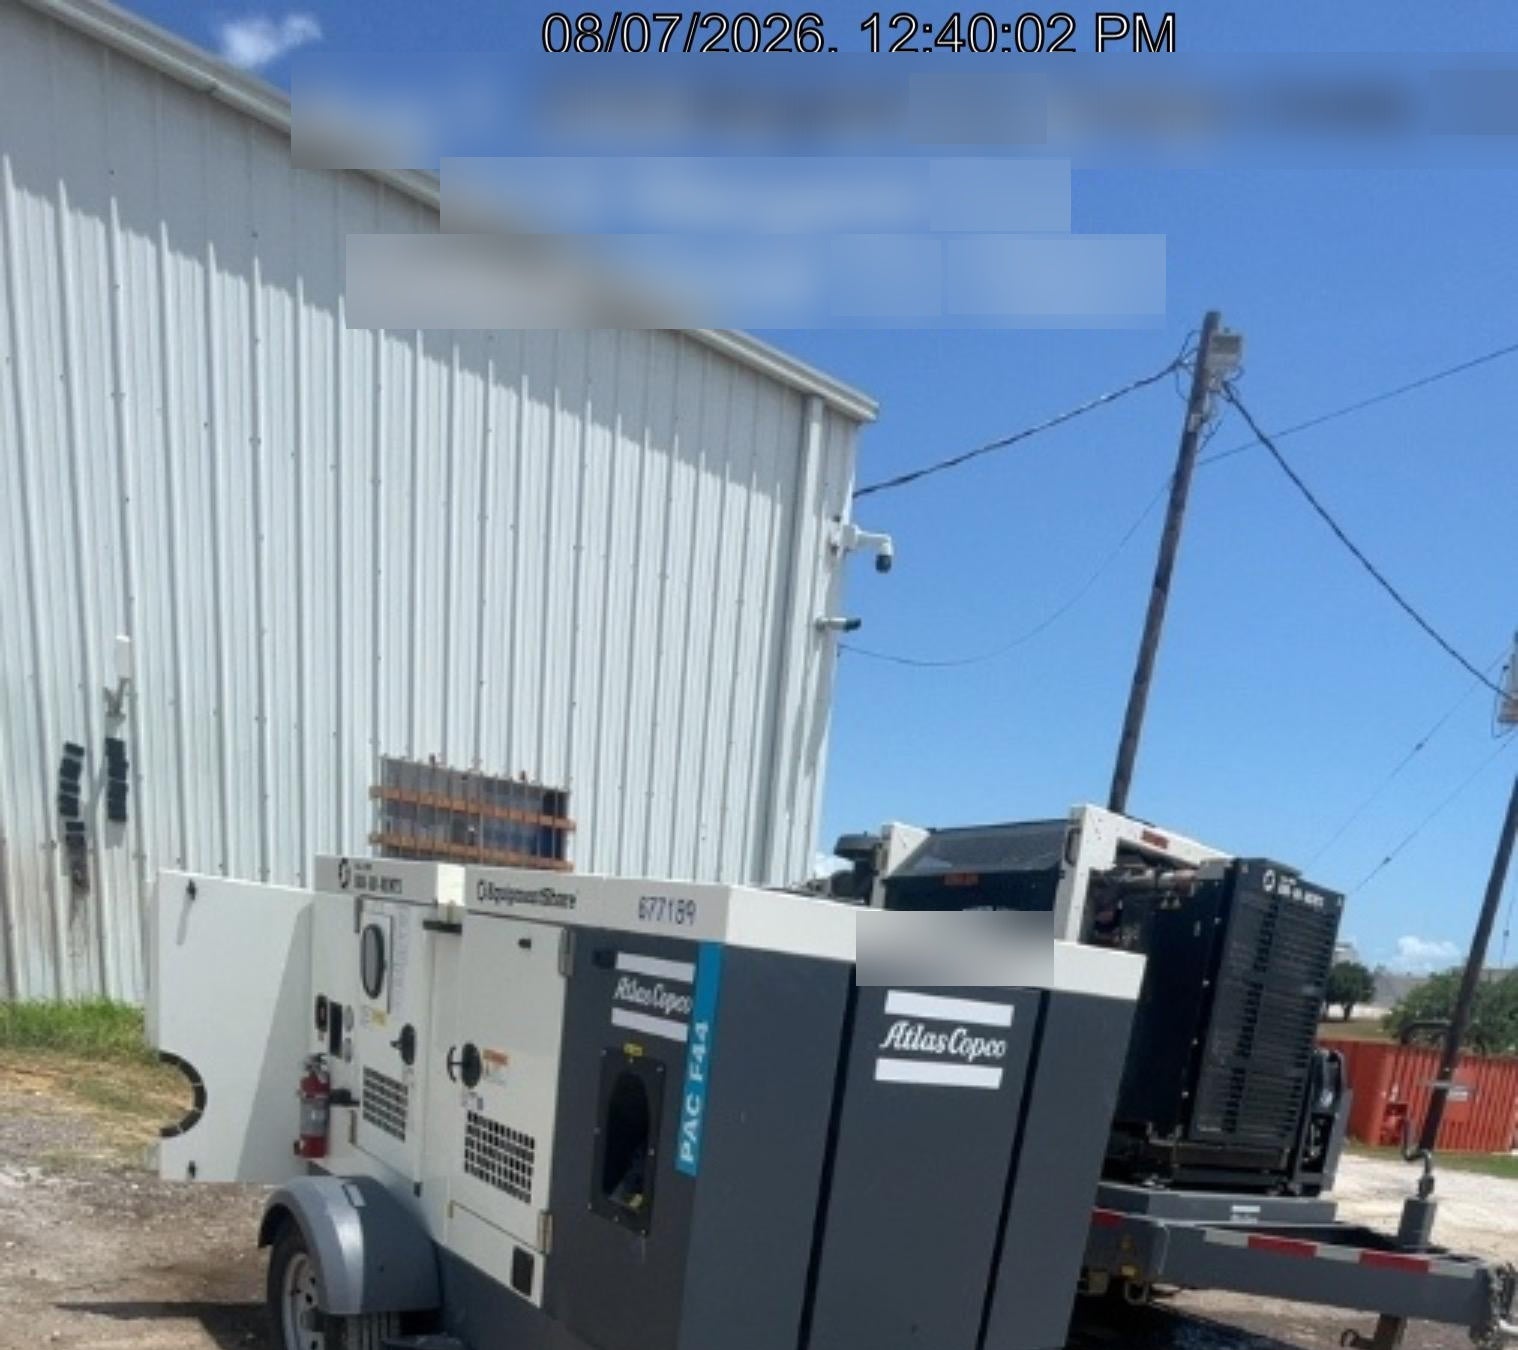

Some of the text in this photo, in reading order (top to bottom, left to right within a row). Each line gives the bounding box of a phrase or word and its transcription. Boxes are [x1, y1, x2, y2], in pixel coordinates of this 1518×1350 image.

[638, 896, 697, 925] 677189
[679, 1021, 709, 1163] PAC F44
